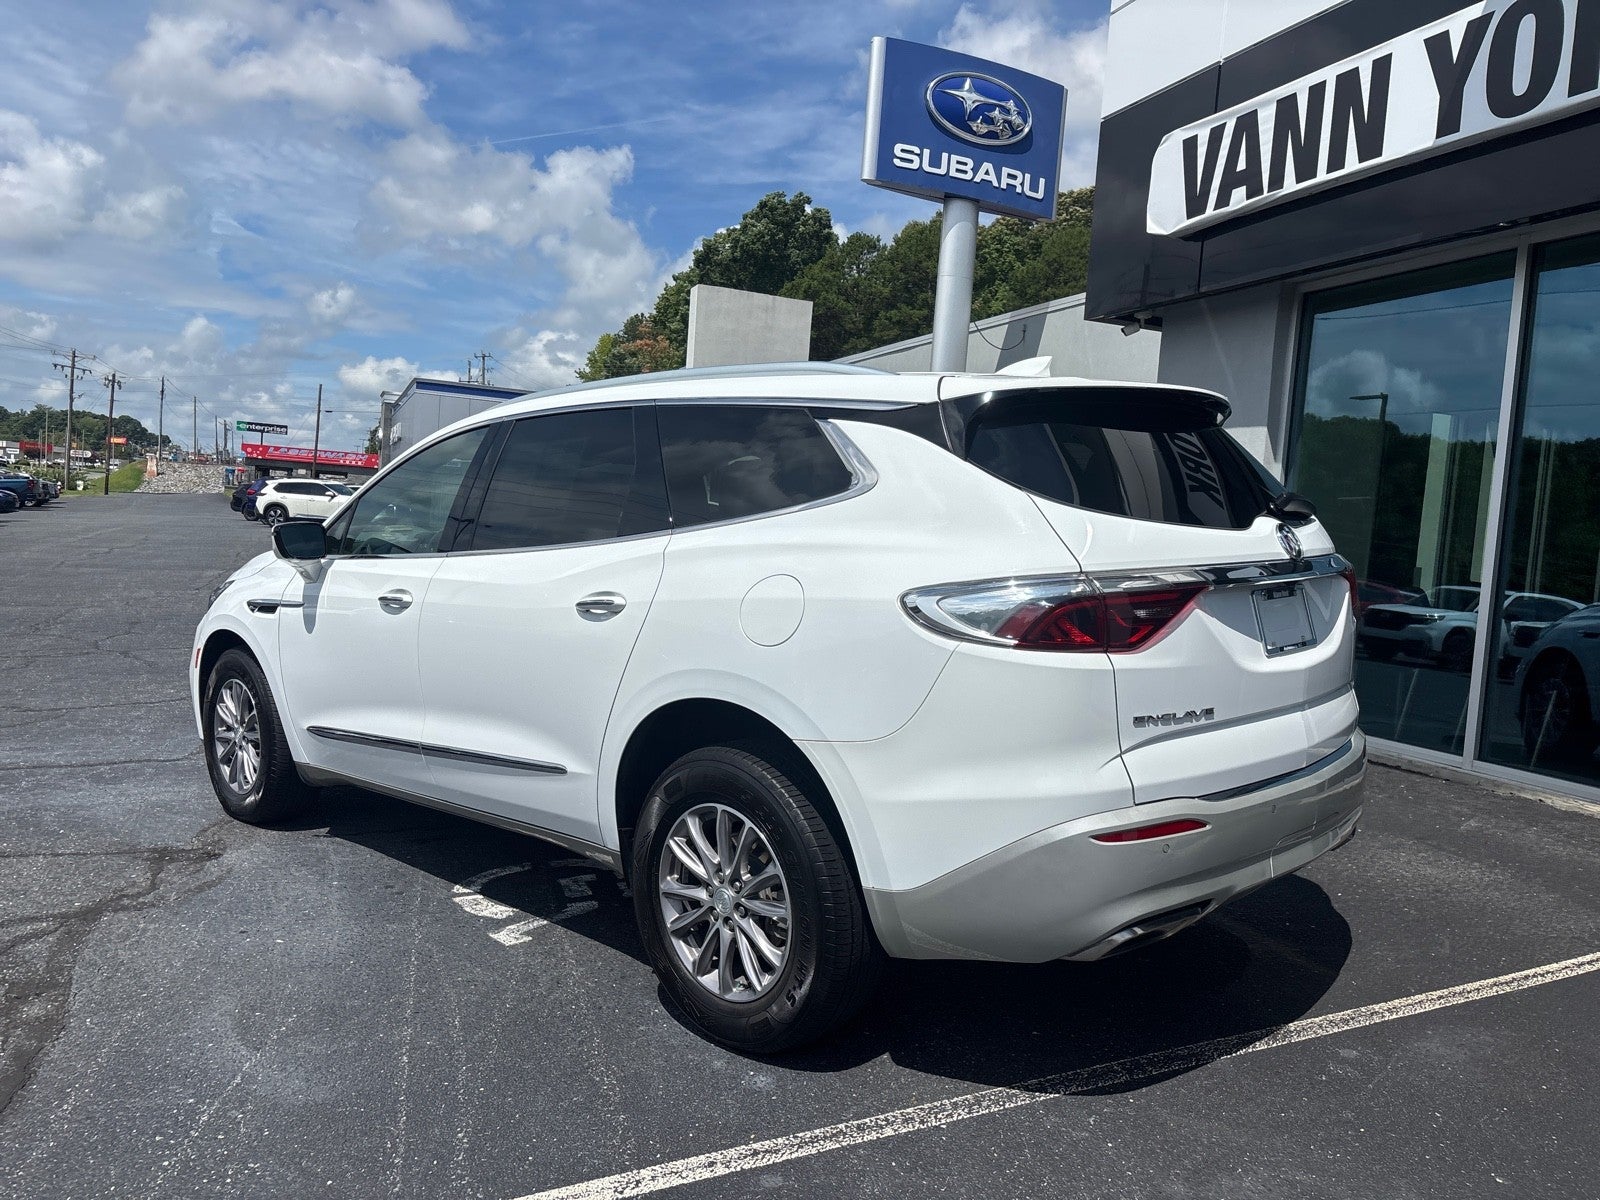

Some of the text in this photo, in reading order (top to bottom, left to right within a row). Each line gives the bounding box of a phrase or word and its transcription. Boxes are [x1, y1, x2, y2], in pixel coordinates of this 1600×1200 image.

[1182, 52, 1394, 221] VANN
[893, 143, 1045, 200] SUBARU
[238, 422, 287, 432] enterprise
